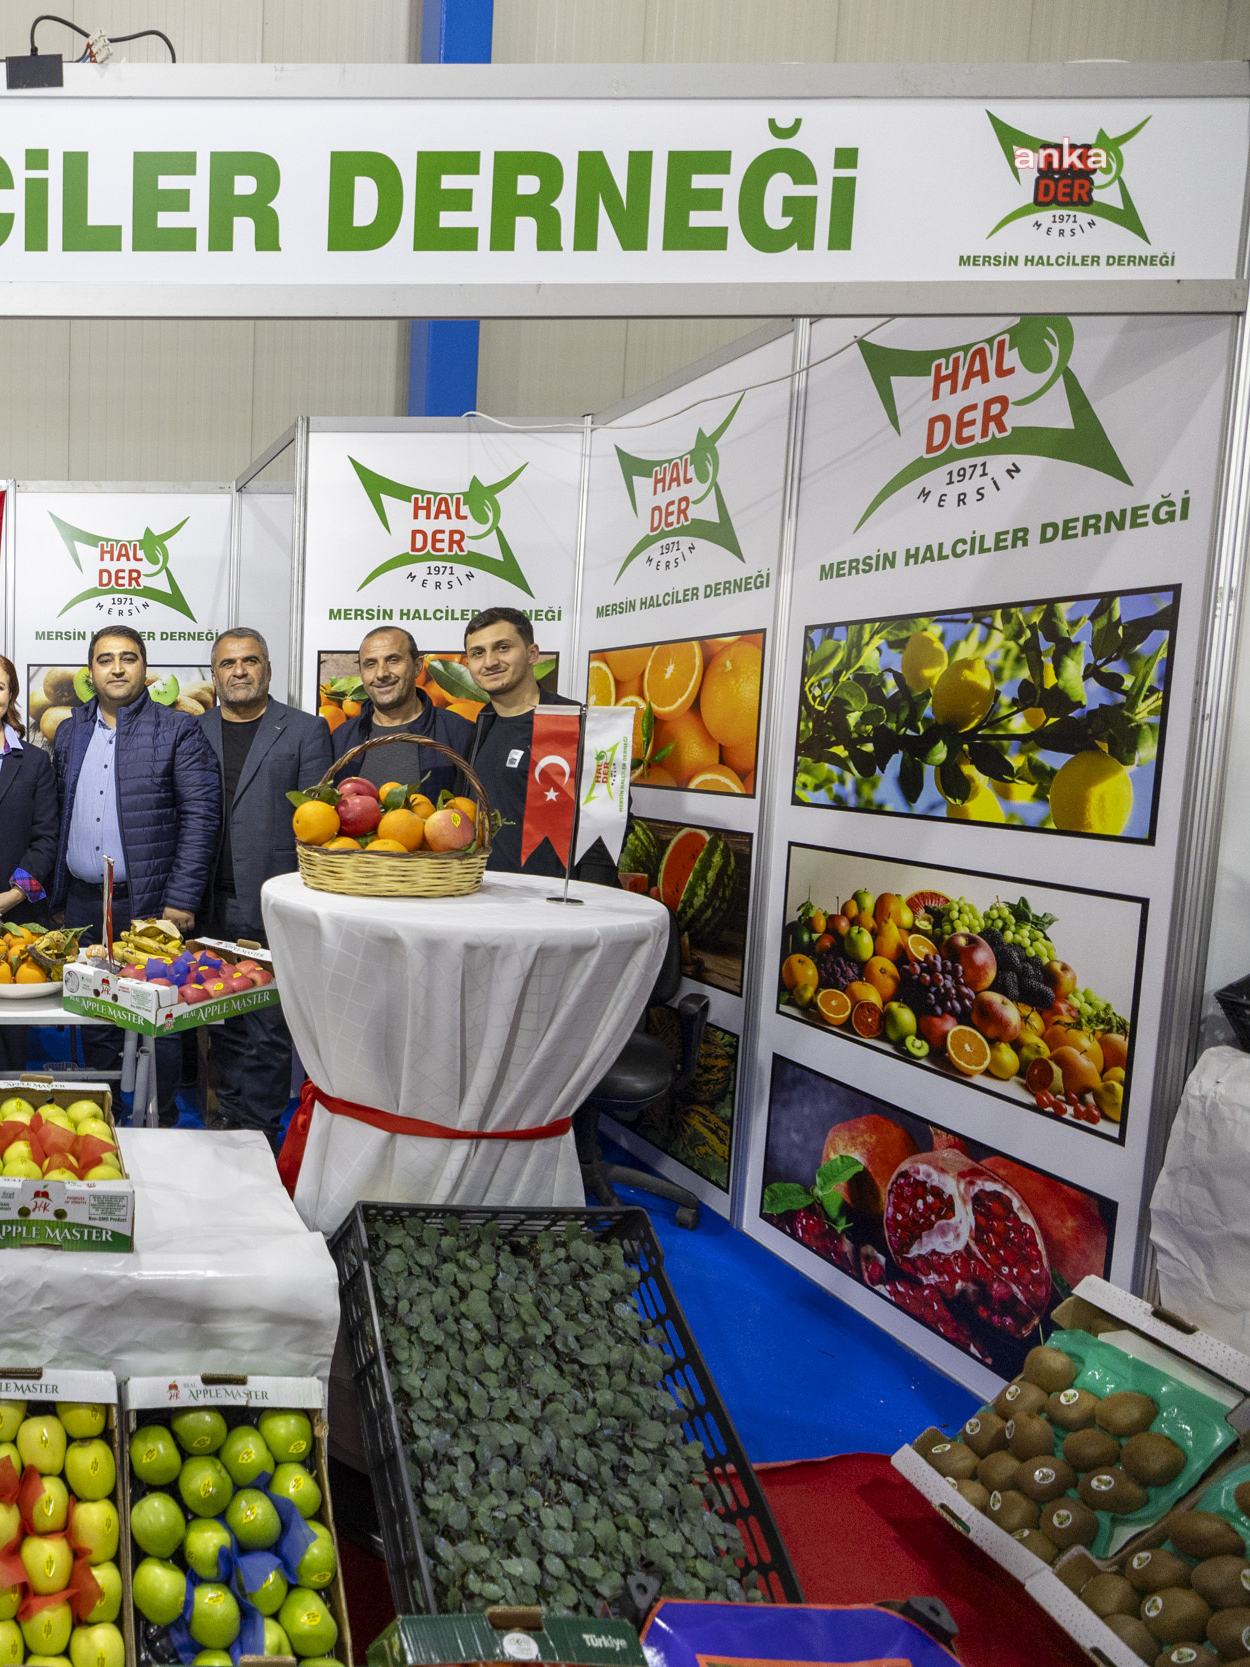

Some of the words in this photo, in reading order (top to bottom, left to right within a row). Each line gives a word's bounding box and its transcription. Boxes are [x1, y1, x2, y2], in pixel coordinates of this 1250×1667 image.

[1037, 178, 1090, 202] DER
[1051, 214, 1078, 224] 1971
[958, 252, 1019, 267] MERSİN
[1024, 252, 1100, 267] HALCİLER
[1105, 251, 1175, 267] DERNEĞİ
[932, 338, 1016, 401] HAL
[925, 395, 1010, 455] DER
[652, 457, 694, 496] HAL
[945, 461, 989, 486] 1971
[412, 496, 468, 520] HAL
[650, 496, 690, 533] DER
[410, 529, 465, 553] DER
[819, 548, 896, 581] MERSİN
[904, 530, 1030, 567] HALCİLER
[1039, 489, 1191, 543] DERNEĞİ
[100, 543, 143, 562] HAL
[659, 541, 680, 556] 1971
[98, 568, 142, 588] DER
[426, 566, 455, 575] 1971
[111, 597, 134, 605] 1971
[596, 597, 636, 619] MERSİN
[639, 587, 699, 611] HALCİLER
[703, 568, 770, 599] DERNEĞİ
[329, 605, 393, 621] MERSİN
[35, 628, 86, 641] MERSİN
[602, 761, 610, 784] DER
[81, 999, 107, 1014] APPLE
[107, 1005, 145, 1026] MASTER
[182, 1010, 196, 1019] REAL
[197, 1003, 229, 1021] APPLE
[231, 991, 270, 1011] MASTER
[44, 1225, 113, 1242] MASTER
[13, 1382, 59, 1395] MASTER
[188, 1388, 222, 1401] APPLE
[223, 1387, 269, 1400] MASTER
[581, 1633, 628, 1651] Türkiye
